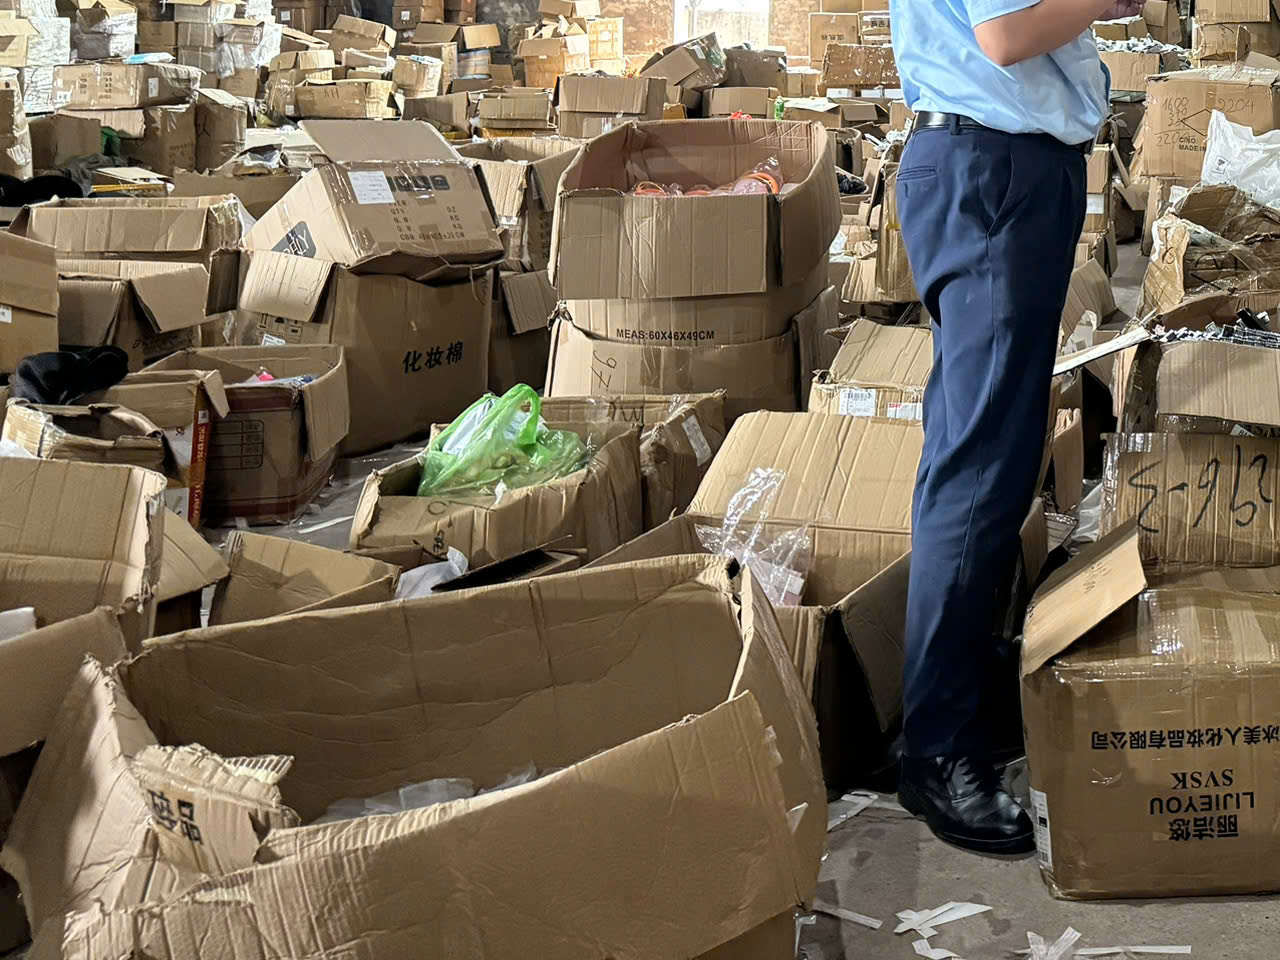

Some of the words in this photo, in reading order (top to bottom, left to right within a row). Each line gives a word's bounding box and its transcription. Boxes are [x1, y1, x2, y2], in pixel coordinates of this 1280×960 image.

[1178, 144, 1199, 152] MADE
[616, 328, 715, 341] MEAS:60X46X49CM
[402, 341, 463, 374] 化妆棉
[1170, 768, 1234, 790] SVSK
[1149, 791, 1255, 815] LIJIEYOU
[1169, 814, 1239, 841] 丽洁悠
